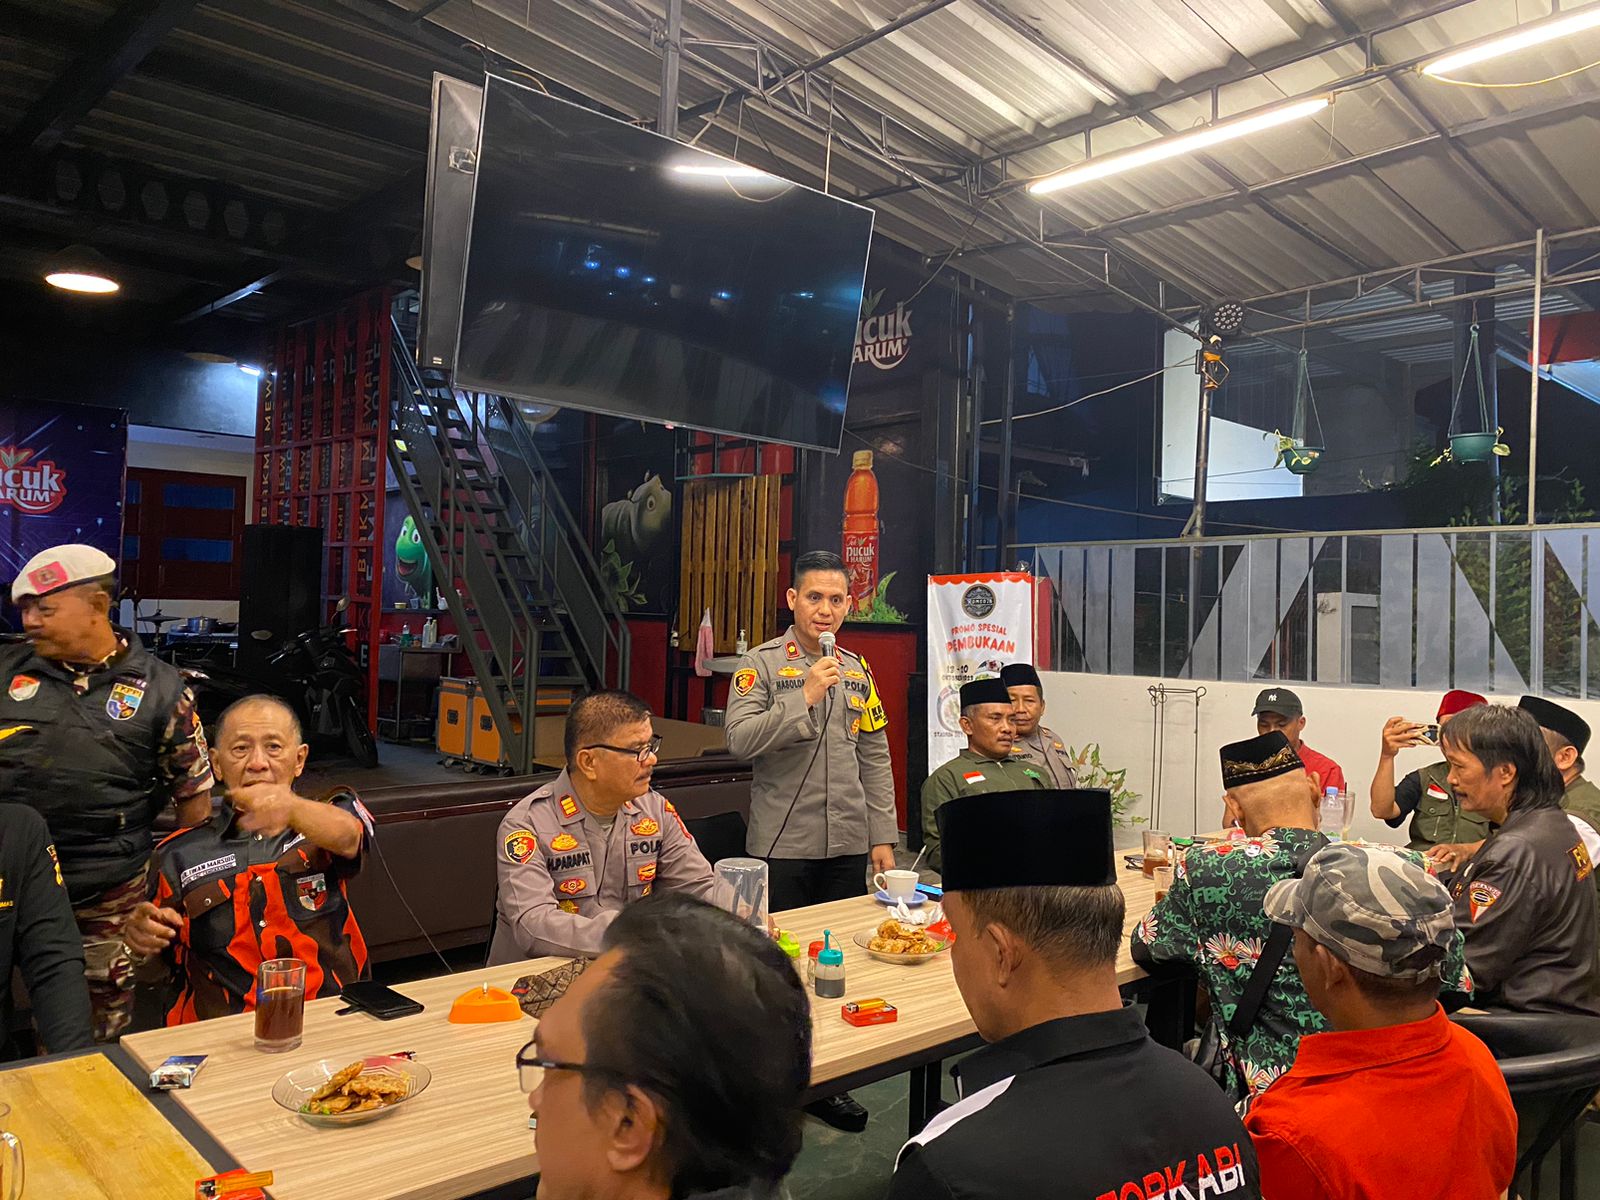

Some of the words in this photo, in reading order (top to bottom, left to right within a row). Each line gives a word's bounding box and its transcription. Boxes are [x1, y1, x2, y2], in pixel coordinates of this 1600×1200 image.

[951, 624, 976, 636] PROMO
[978, 623, 1007, 636] SPESIAL
[945, 636, 1015, 655] PEMBUKAAN
[844, 680, 869, 694] POLRI
[1192, 886, 1229, 905] FBR
[1095, 1143, 1245, 1200] RKABI
